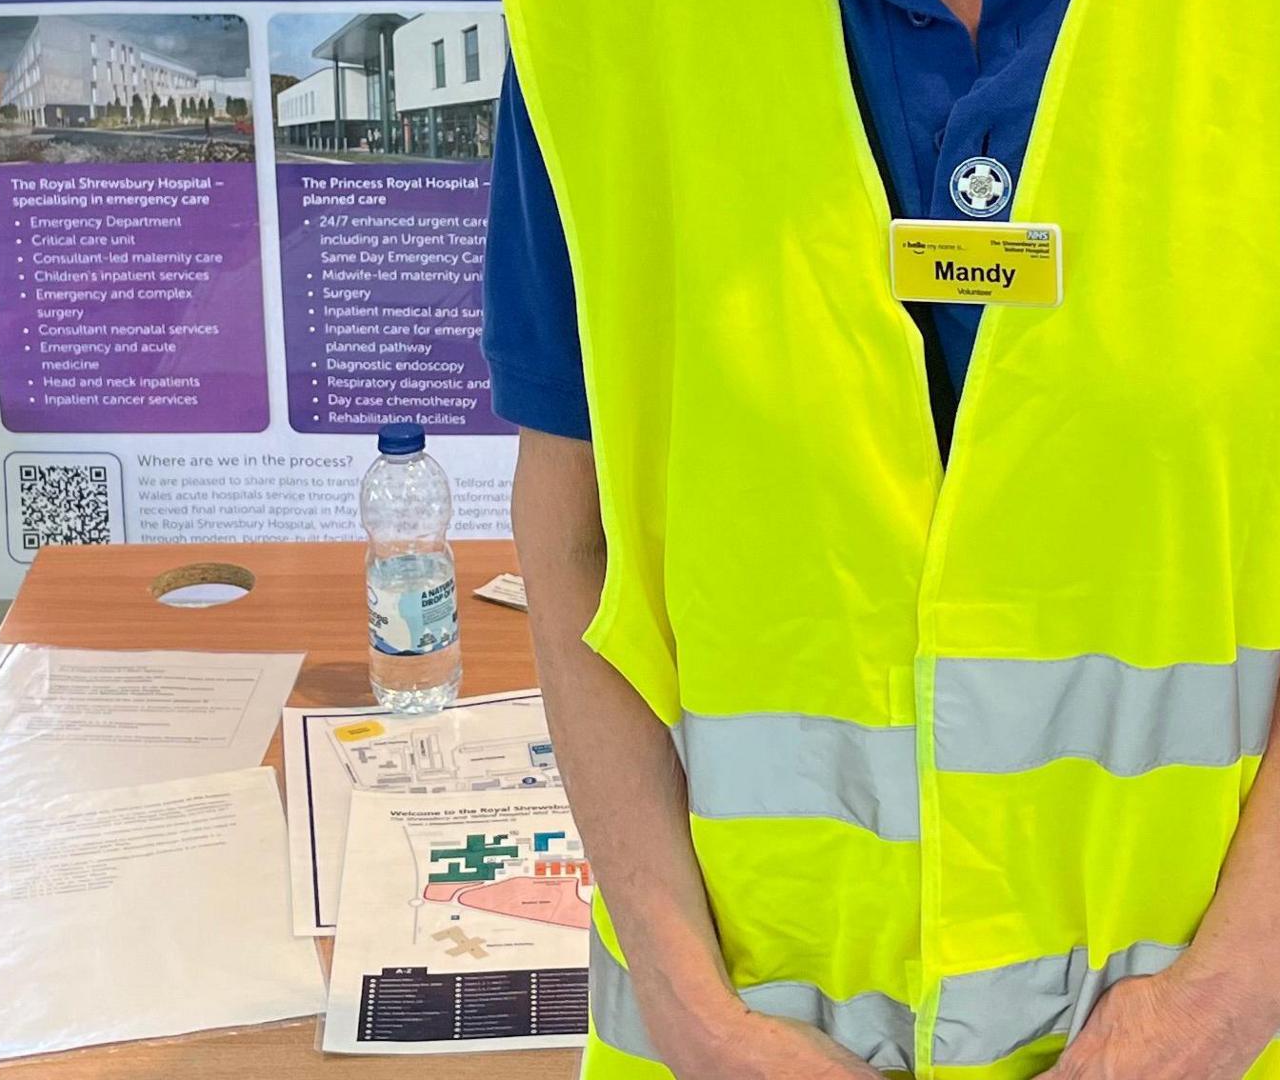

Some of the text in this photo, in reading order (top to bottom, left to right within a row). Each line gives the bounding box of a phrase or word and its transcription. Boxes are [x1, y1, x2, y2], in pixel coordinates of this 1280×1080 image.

[11, 177, 211, 192] The Royal Shrewsbury Hospital
[301, 177, 479, 192] The Princess Royal Hospital
[13, 194, 210, 208] specialising in emergency care
[303, 193, 386, 207] planned care
[30, 215, 182, 230] Emergency Department
[31, 234, 135, 247] Critical care unit
[1028, 231, 1049, 240] NHS
[33, 251, 223, 266] Consultant-led maternity care
[934, 261, 1016, 288] Mandy
[36, 287, 193, 302] Emergency and complex
[323, 287, 371, 301] Surgery
[37, 309, 84, 321] surgery
[38, 323, 219, 336] Consultant neonatal services
[40, 341, 176, 355] Emergency and acute
[42, 359, 99, 370] medicine
[44, 393, 198, 407] Inpatient cancer services
[137, 454, 353, 469] Where are we in the process?
[422, 595, 443, 608] DROP
[480, 806, 510, 814] Royal
